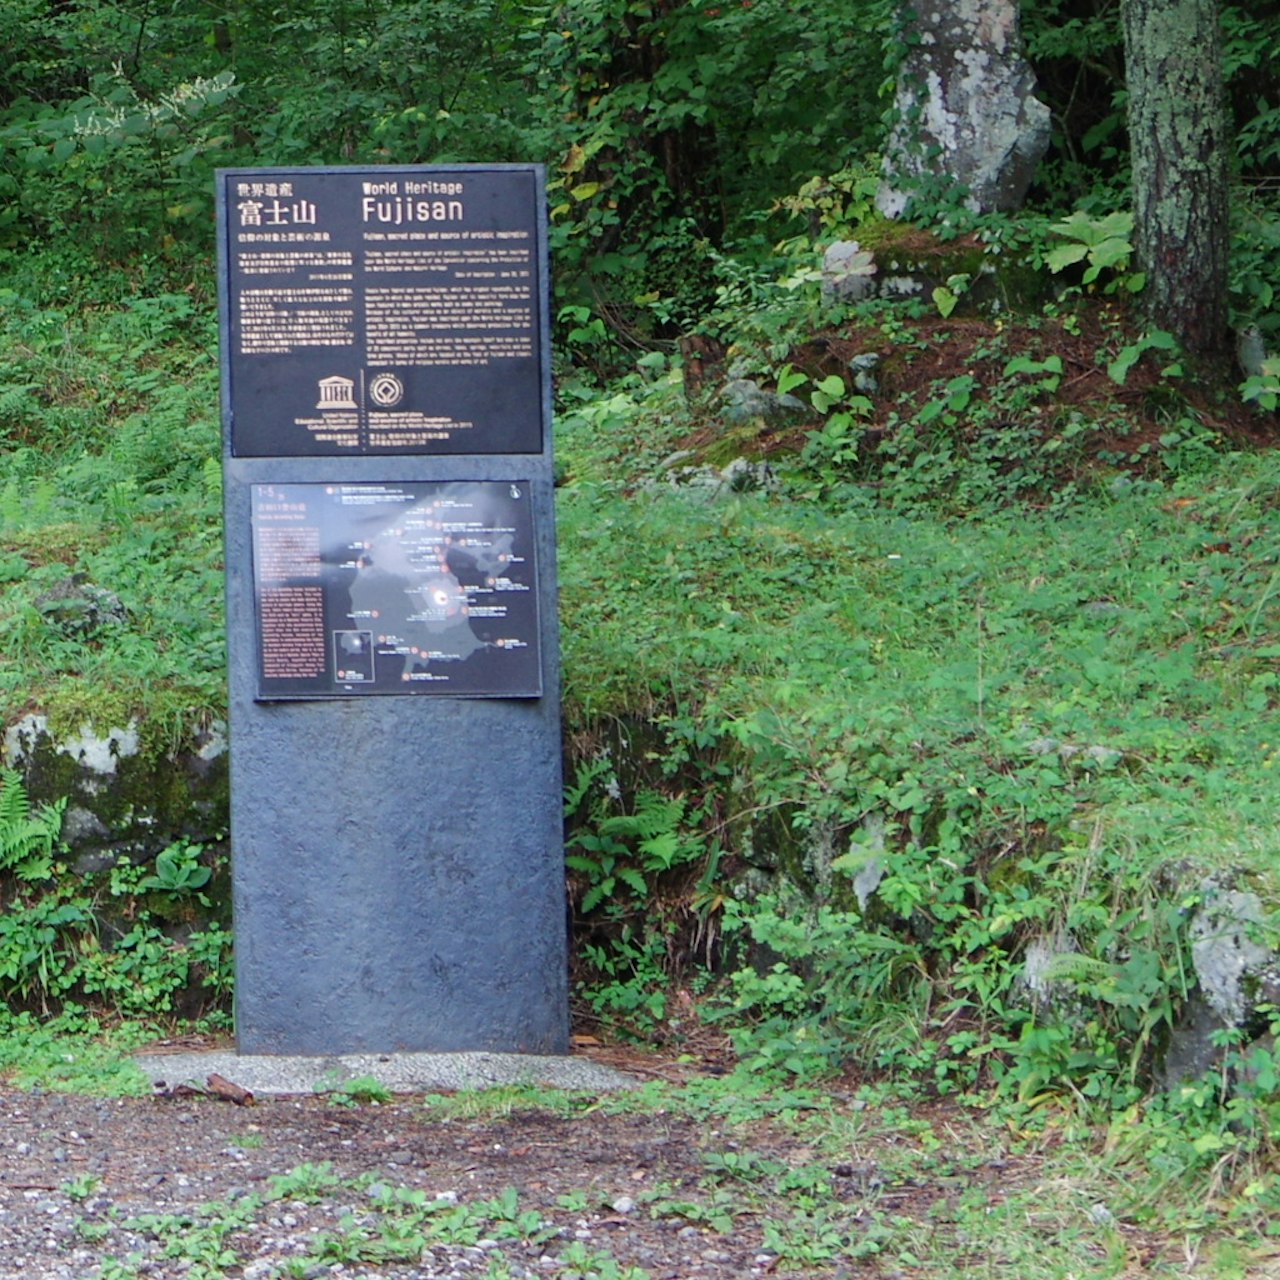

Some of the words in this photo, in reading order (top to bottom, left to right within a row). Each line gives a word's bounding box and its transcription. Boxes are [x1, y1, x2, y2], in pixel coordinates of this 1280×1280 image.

[237, 182, 293, 197] 世界遺産
[362, 182, 397, 195] World
[405, 181, 463, 195] Heritage
[237, 199, 316, 226] 富士山
[362, 197, 463, 225] Fujisan
[461, 231, 469, 239] of
